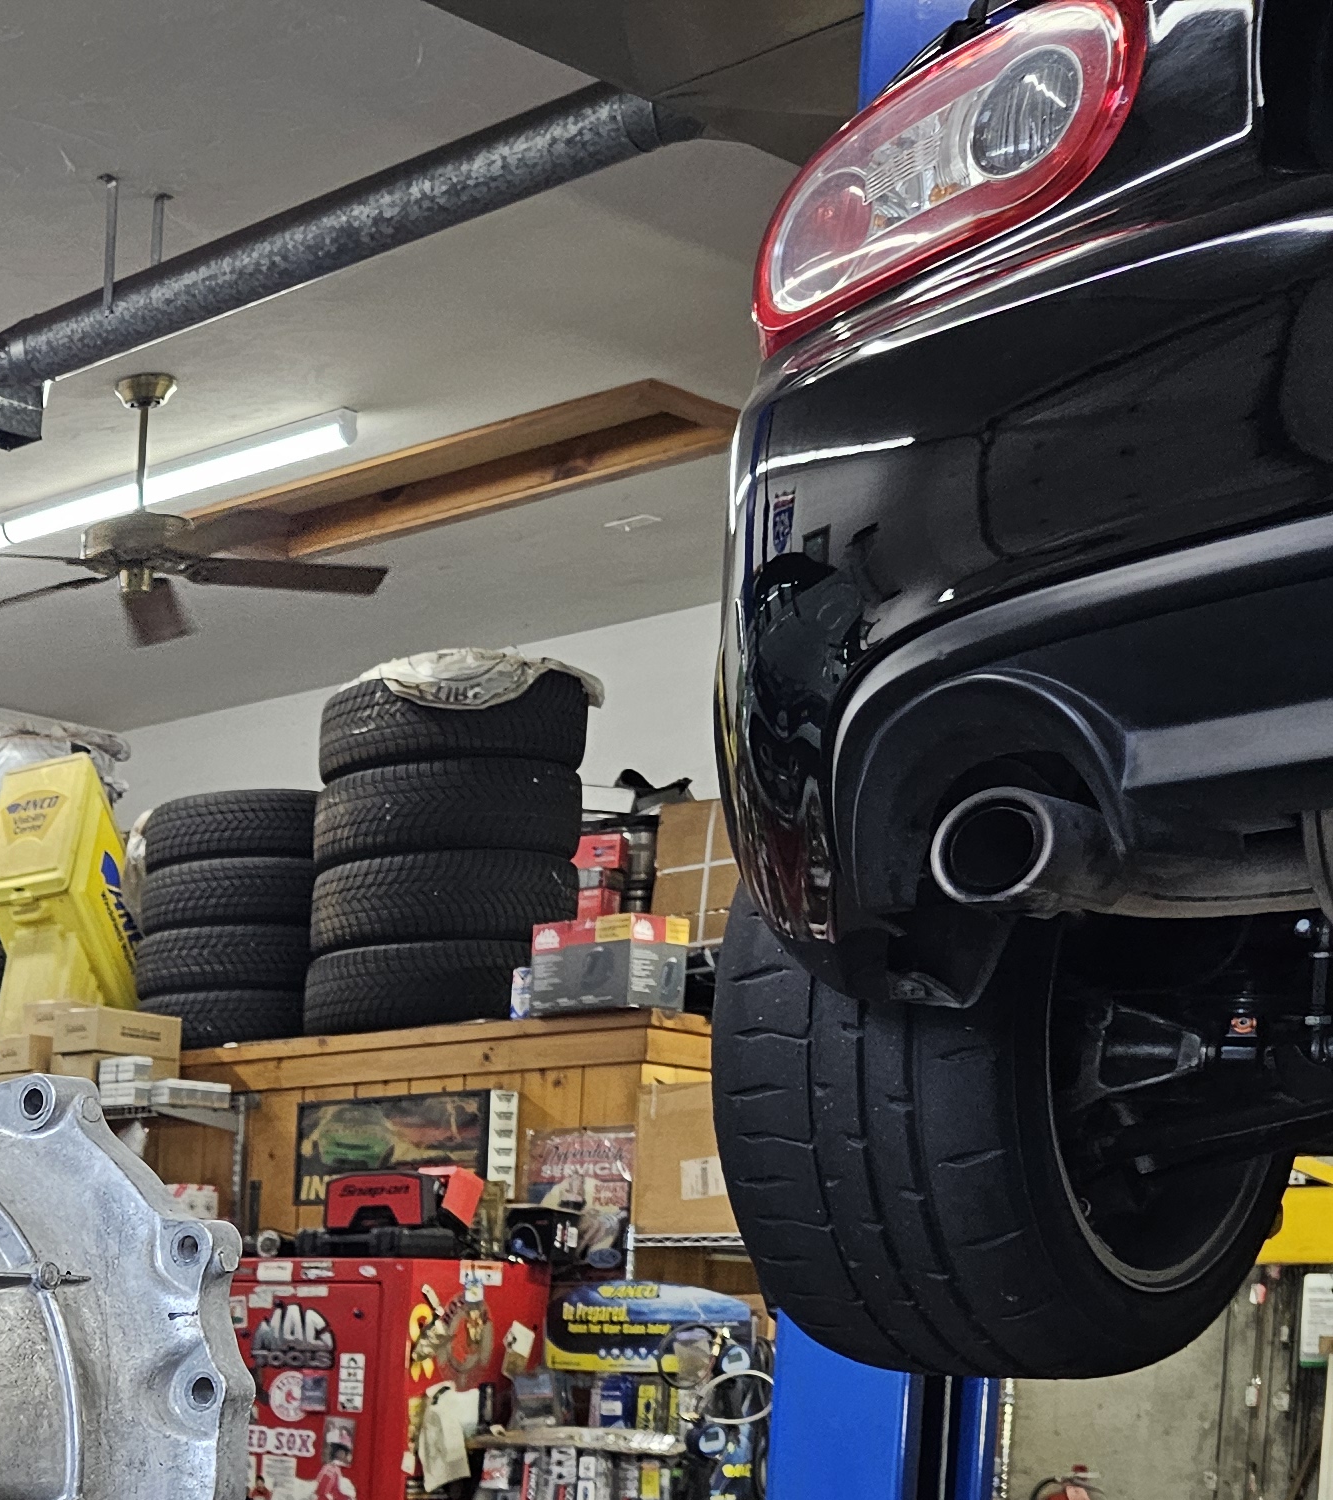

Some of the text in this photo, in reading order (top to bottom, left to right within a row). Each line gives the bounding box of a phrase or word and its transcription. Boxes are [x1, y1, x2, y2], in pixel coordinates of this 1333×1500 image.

[338, 1183, 411, 1198] Snap-on
[252, 1303, 333, 1350] MAC
[251, 1350, 333, 1368] TOOLS
[275, 1431, 312, 1454] SOX
